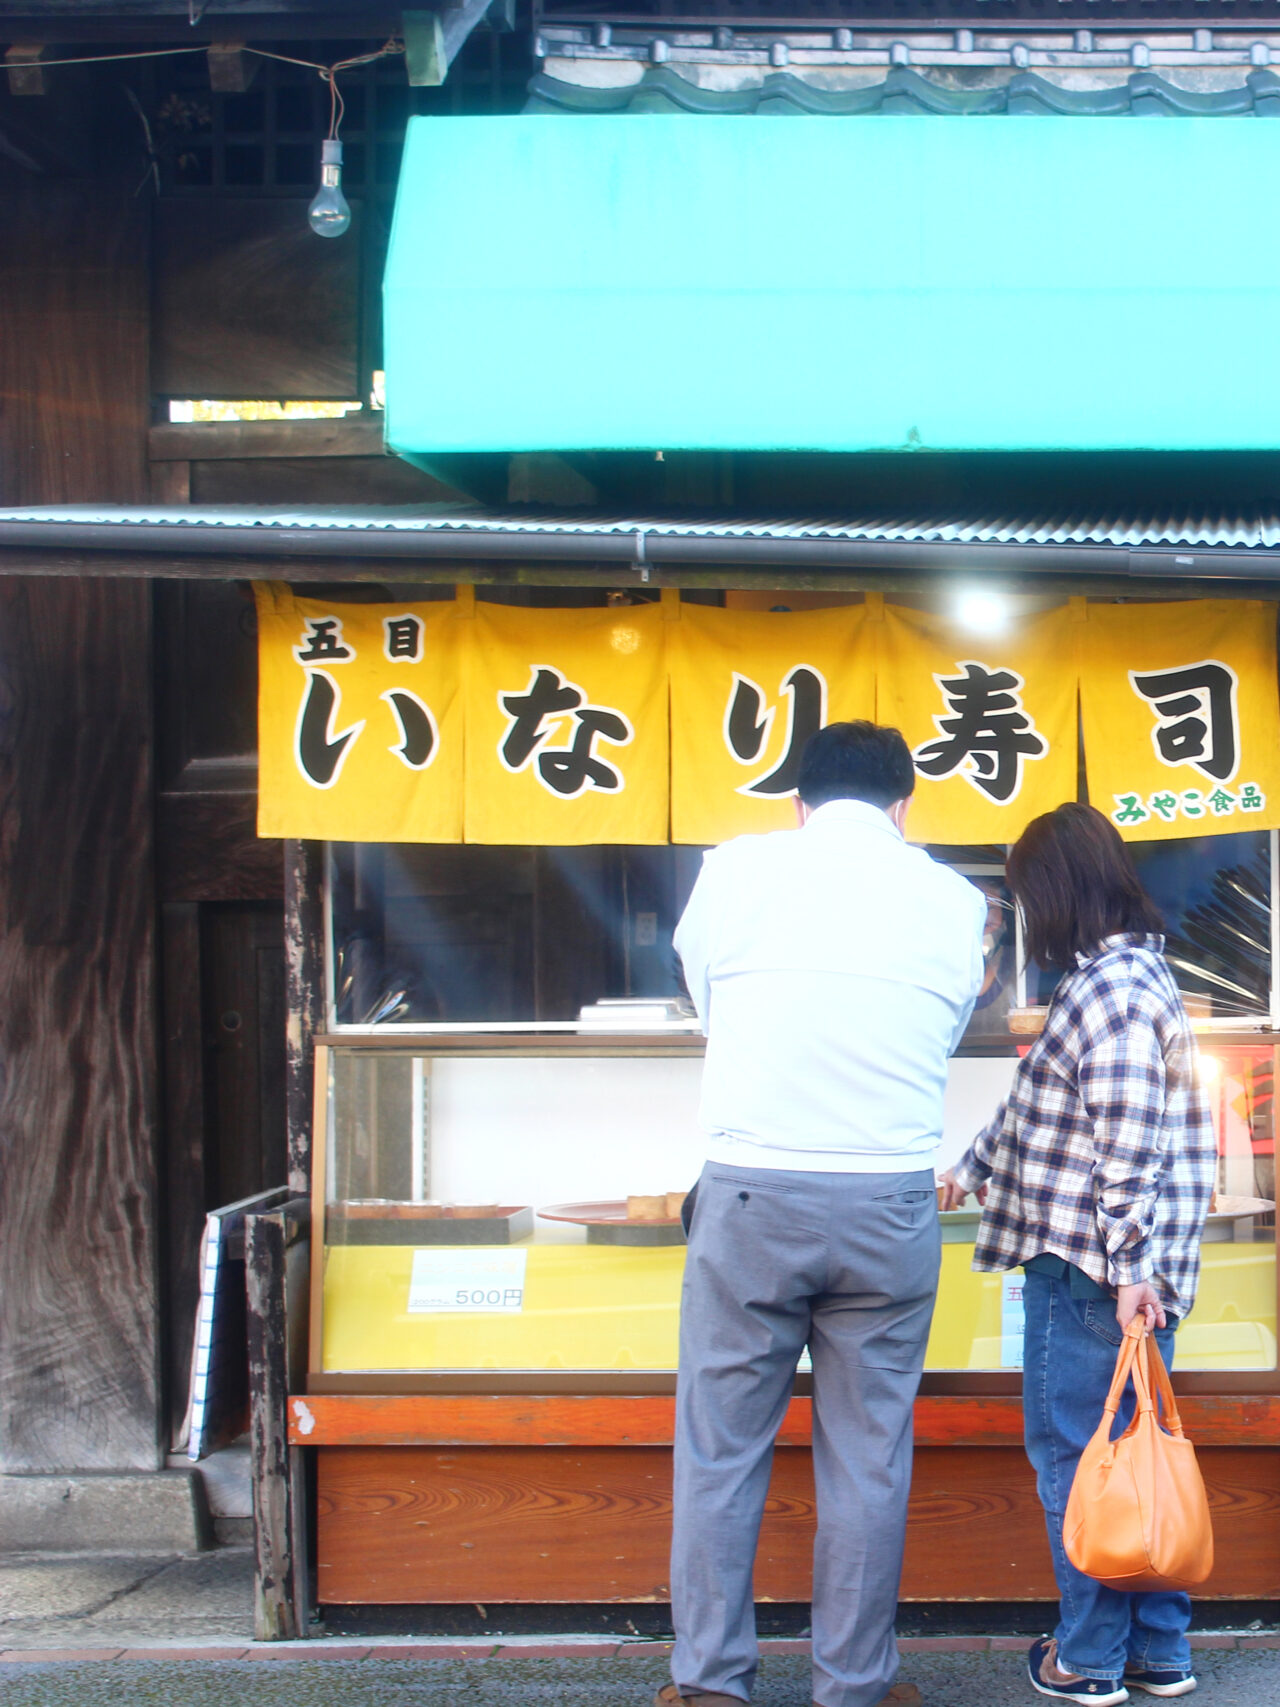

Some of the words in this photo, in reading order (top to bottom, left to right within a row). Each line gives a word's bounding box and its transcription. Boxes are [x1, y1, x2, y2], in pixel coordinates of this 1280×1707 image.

[296, 615, 422, 662] 五目
[296, 660, 1237, 804] いなり寿司
[1115, 785, 1263, 823] みやこ食品
[455, 1289, 523, 1307] 500円
